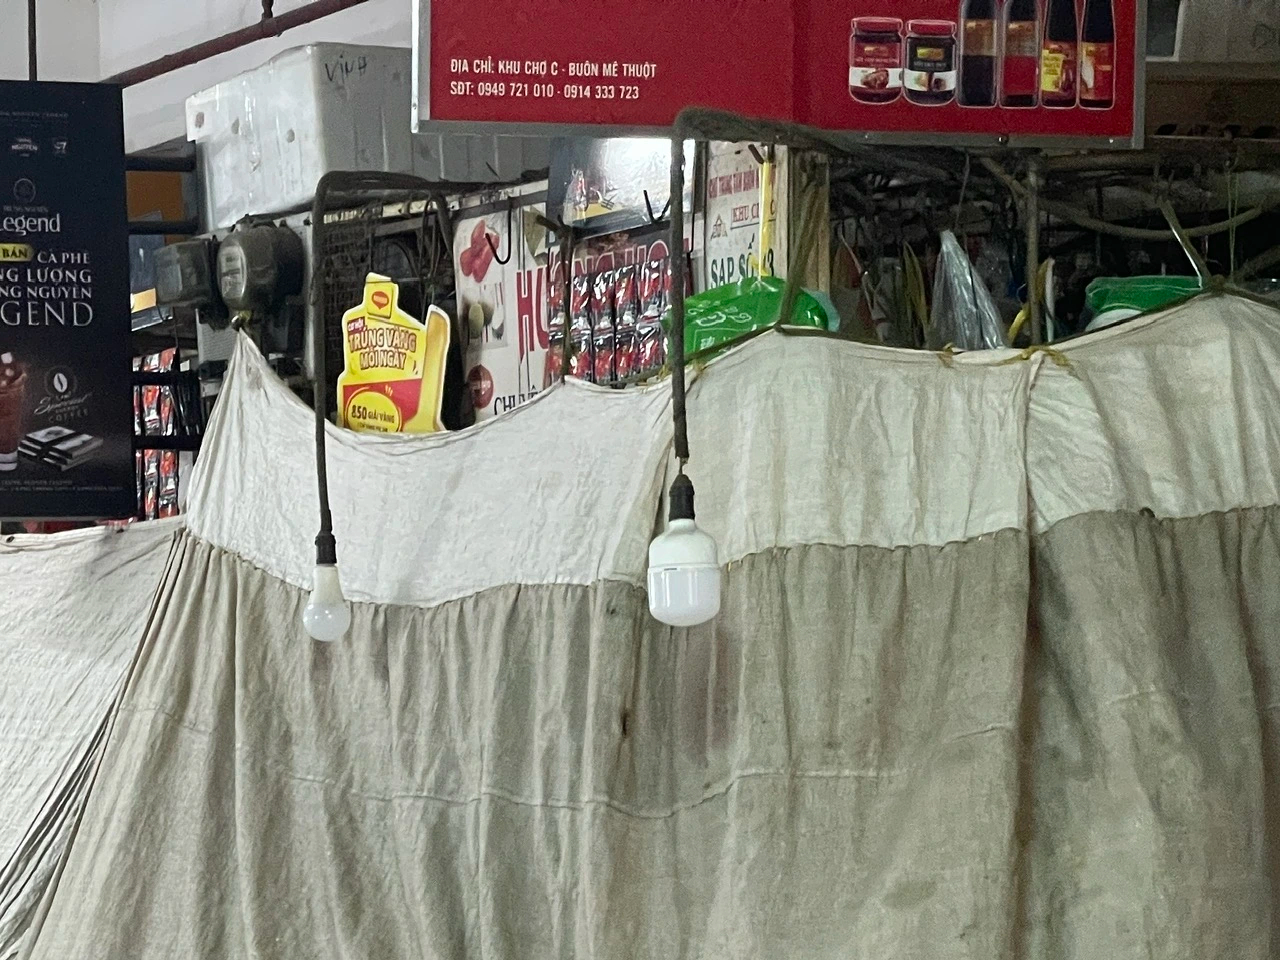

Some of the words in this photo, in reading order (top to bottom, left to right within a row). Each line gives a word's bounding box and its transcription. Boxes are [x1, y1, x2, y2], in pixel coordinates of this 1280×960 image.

[451, 58, 469, 75] ĐỊA
[473, 55, 494, 74] CHỈ:
[498, 60, 520, 74] KHU
[524, 60, 548, 77] CHỢ
[551, 61, 558, 76] C
[569, 60, 598, 77] BUÔN
[622, 61, 656, 80] THUỘT
[450, 81, 474, 95] SĐT:
[477, 82, 505, 96] 0949
[509, 83, 528, 97] 721
[533, 83, 554, 98] 010
[564, 85, 590, 99] 0914
[595, 85, 615, 99] 333
[619, 86, 639, 99] 723
[27, 267, 92, 286] LƯỢNG
[27, 284, 92, 299] NGUYÊN
[349, 325, 384, 353] TRÚNG
[351, 404, 367, 420] 850
